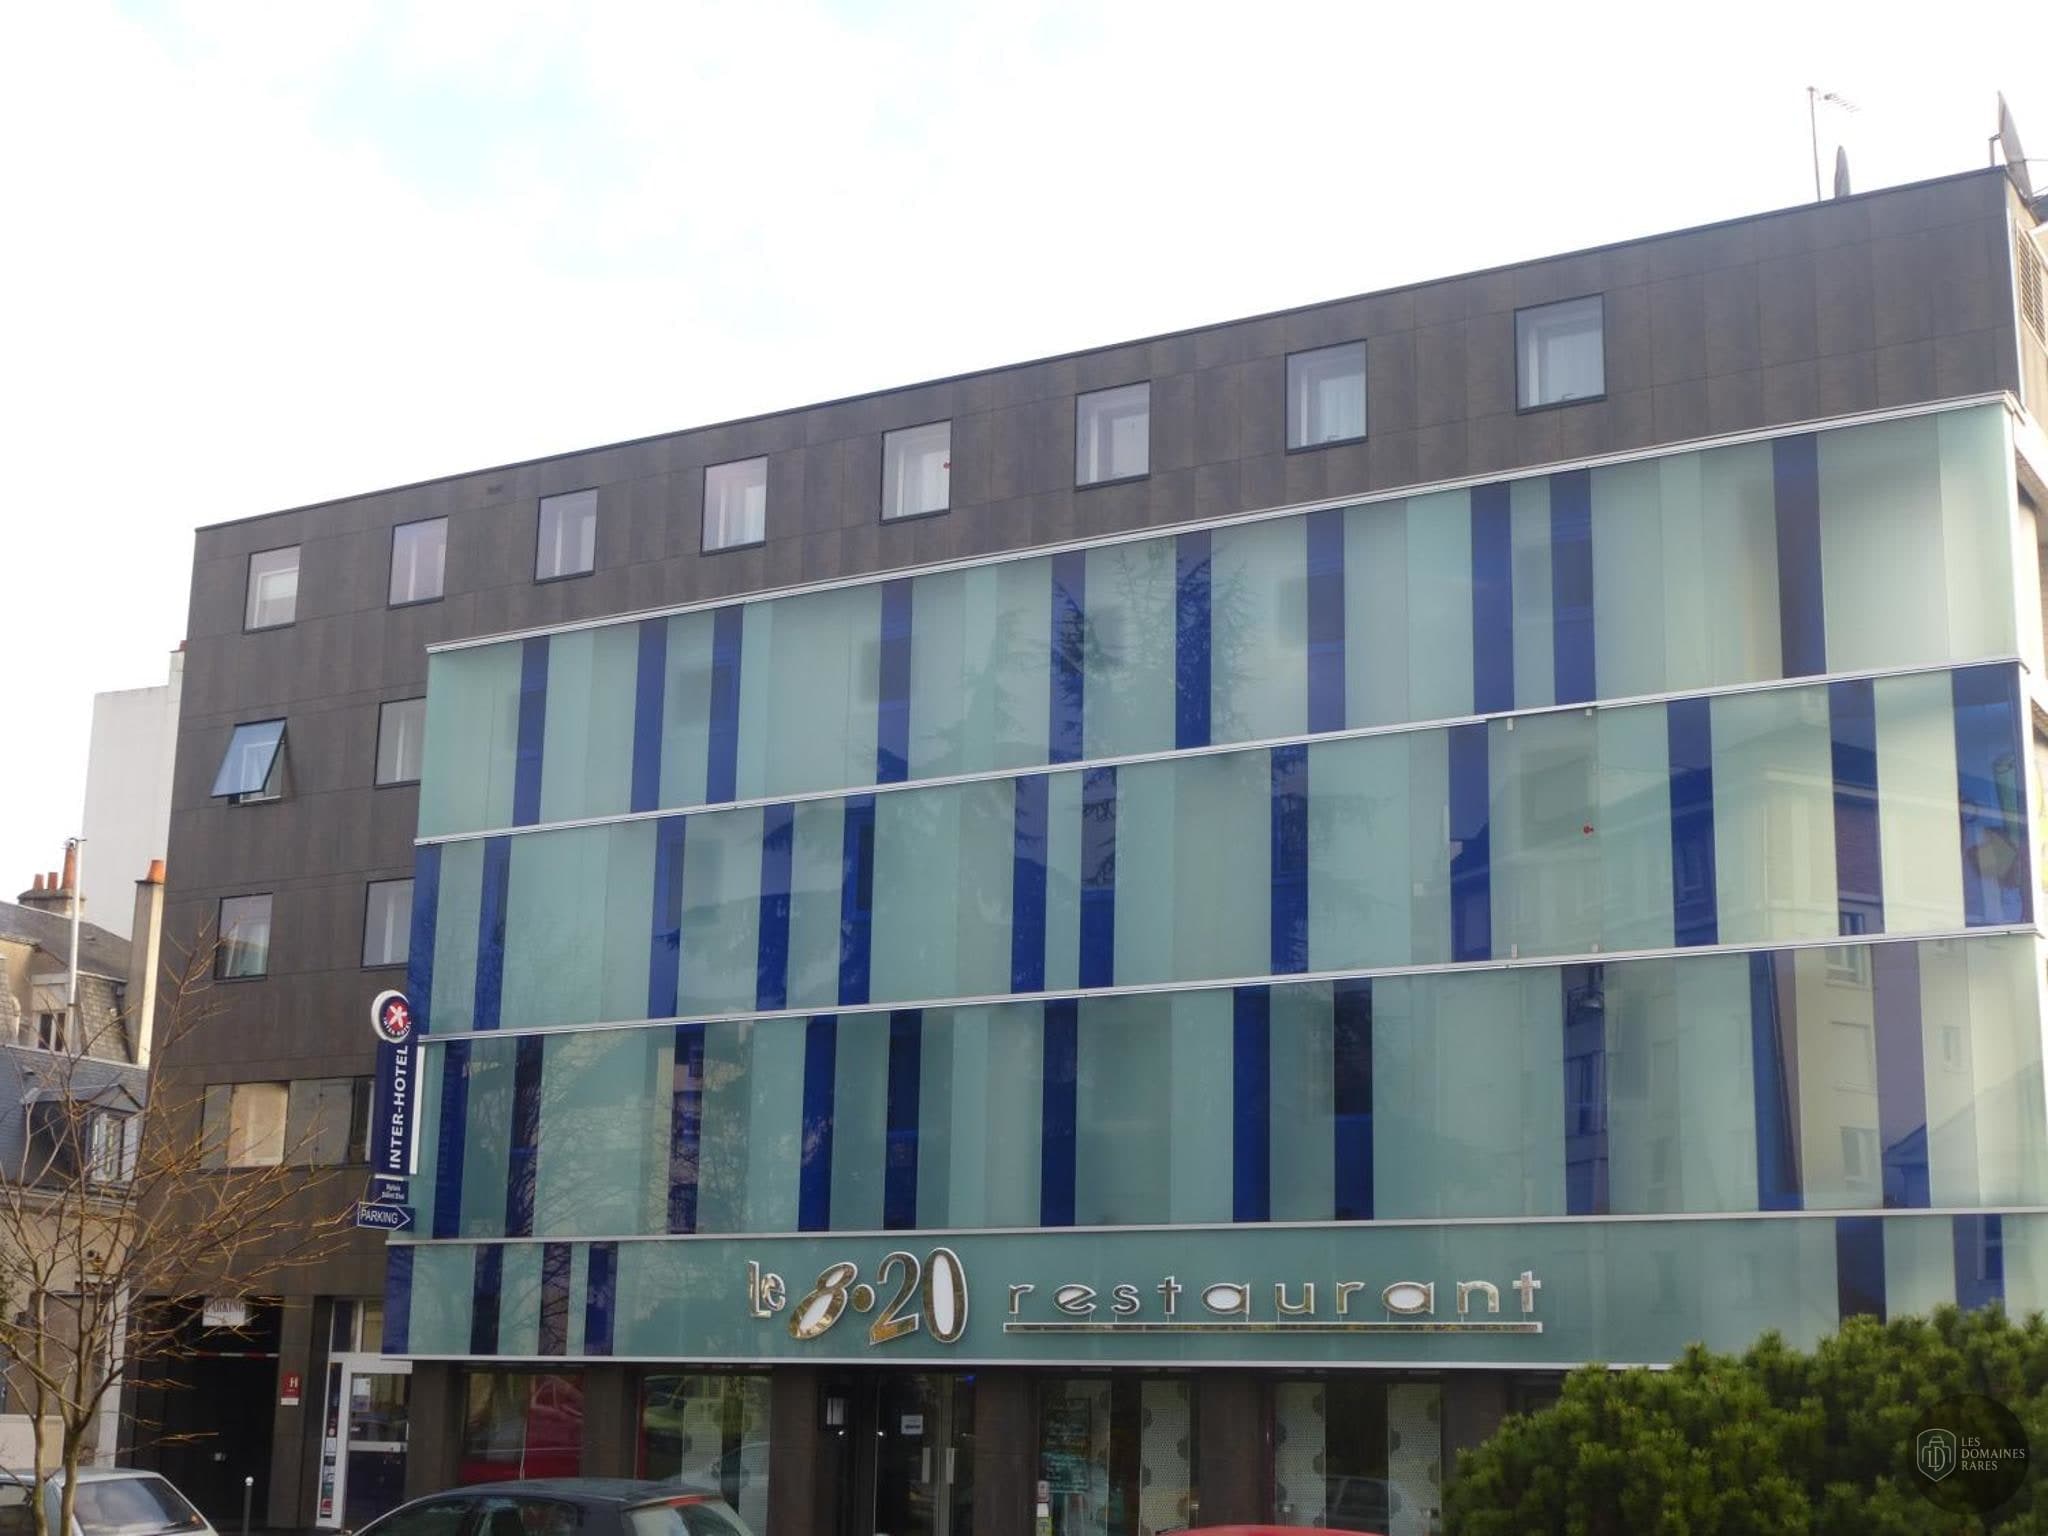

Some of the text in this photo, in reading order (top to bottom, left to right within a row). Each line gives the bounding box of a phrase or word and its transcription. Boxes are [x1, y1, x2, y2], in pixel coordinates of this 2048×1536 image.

[389, 1045, 408, 1169] INTER-HOTEL
[360, 1208, 398, 1224] PARKING
[1008, 1270, 1542, 1315] restaurant
